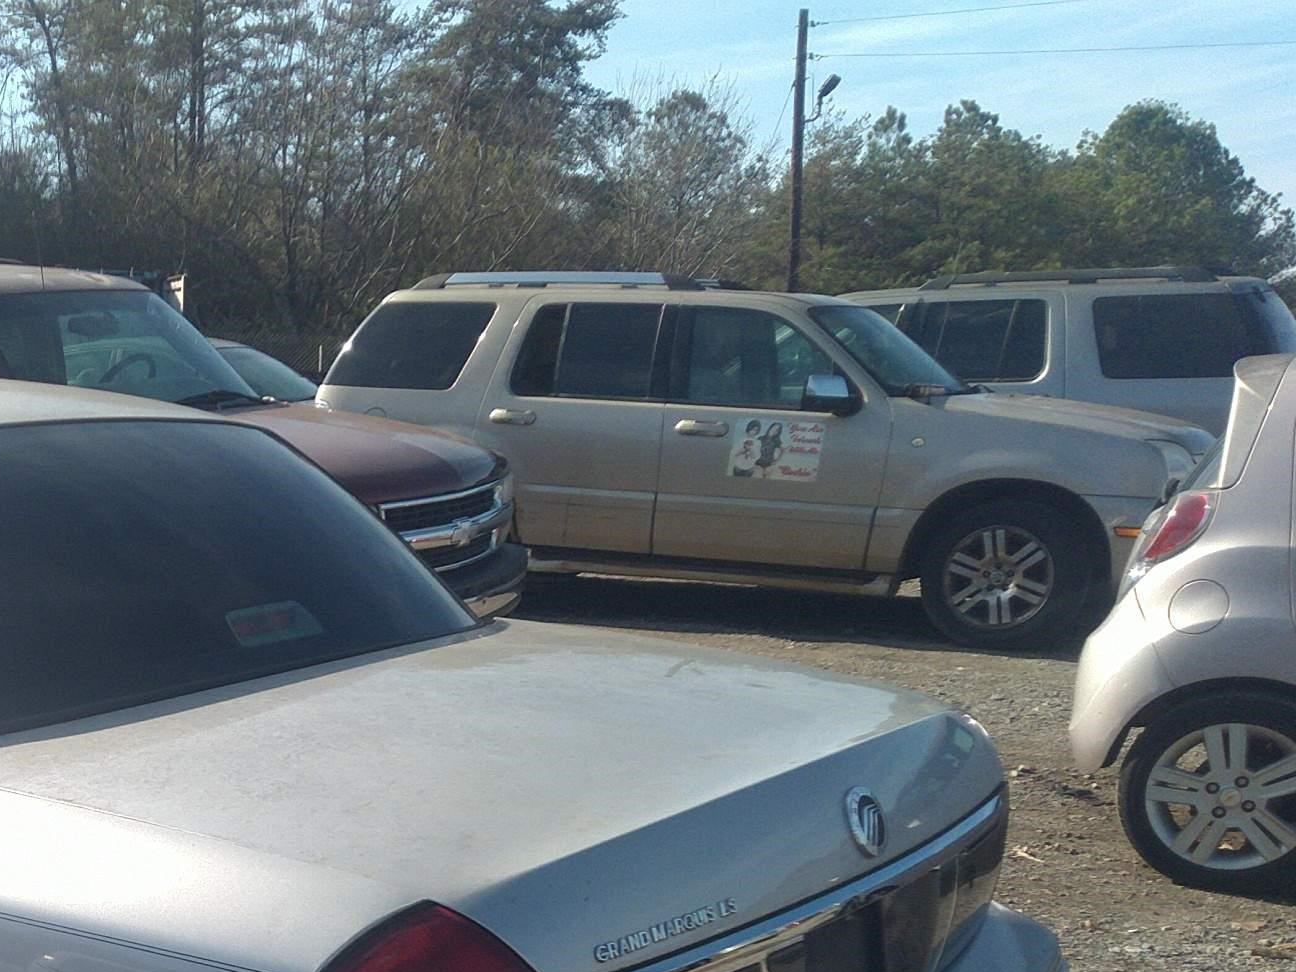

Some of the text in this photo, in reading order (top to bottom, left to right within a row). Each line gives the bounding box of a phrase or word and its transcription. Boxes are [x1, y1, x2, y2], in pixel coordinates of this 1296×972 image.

[594, 896, 737, 963] GRAND MARQUIS LS
